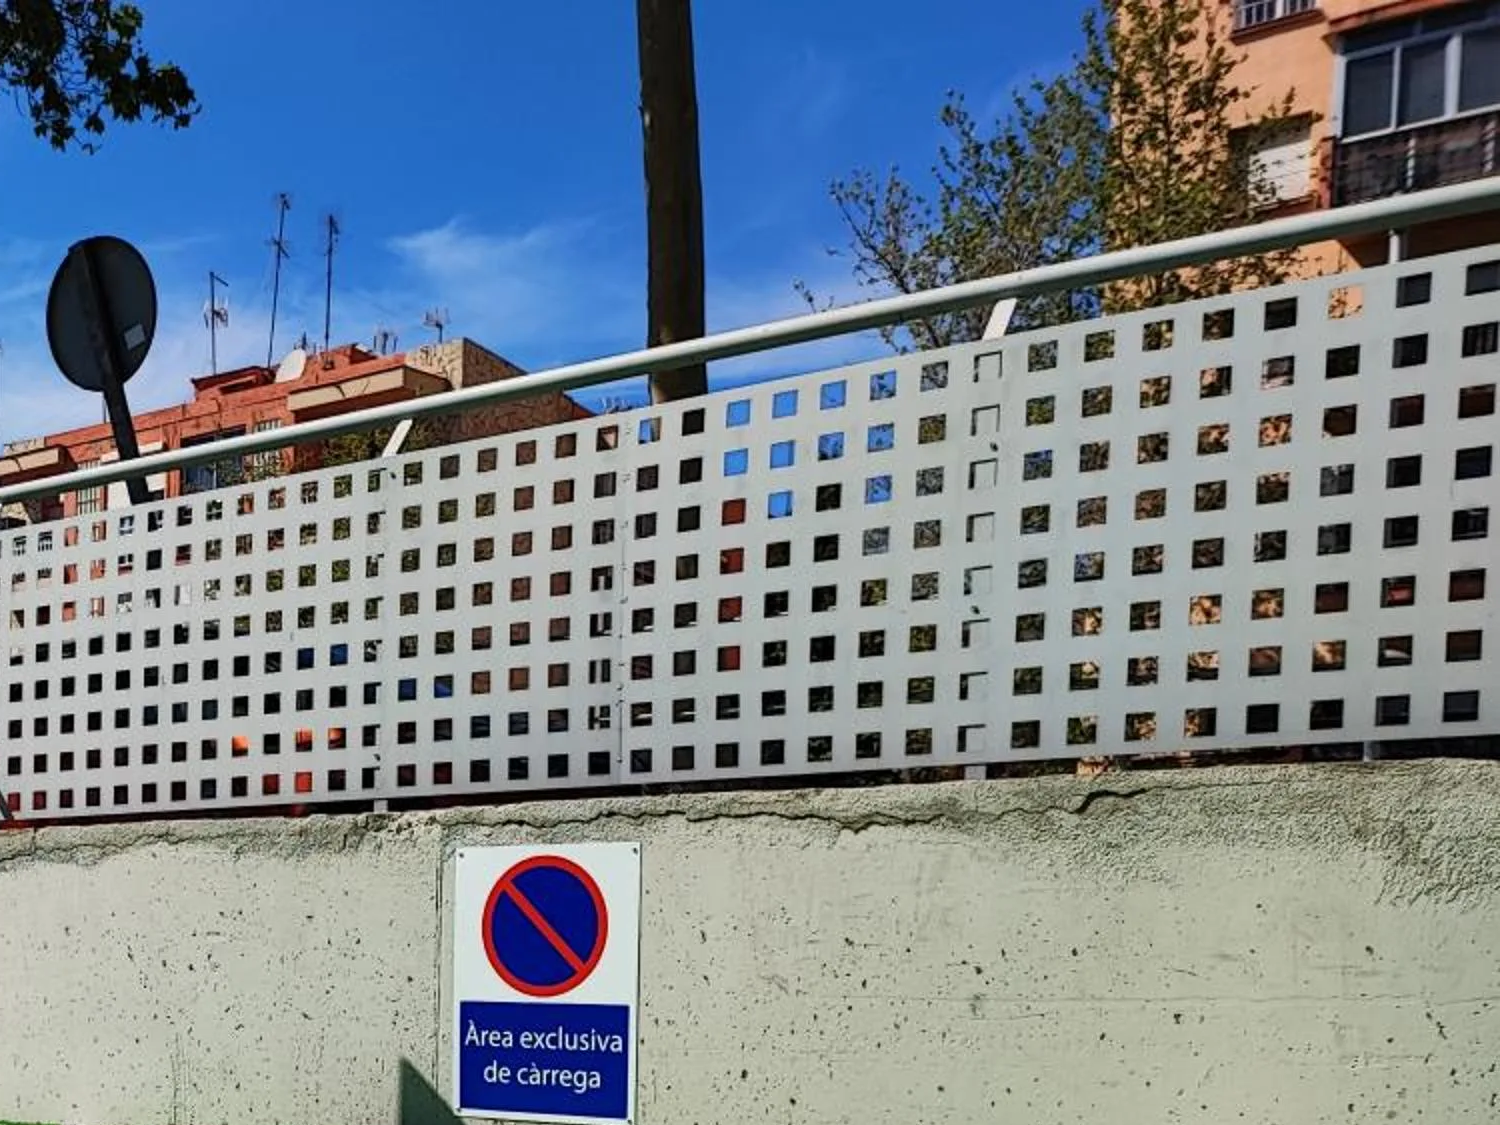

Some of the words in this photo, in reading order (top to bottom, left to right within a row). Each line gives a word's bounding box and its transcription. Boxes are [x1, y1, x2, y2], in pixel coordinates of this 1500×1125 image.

[465, 1020, 513, 1048] Àrea
[519, 1026, 623, 1053] exclusiva
[483, 1060, 511, 1084] de
[517, 1062, 601, 1093] càrrega
